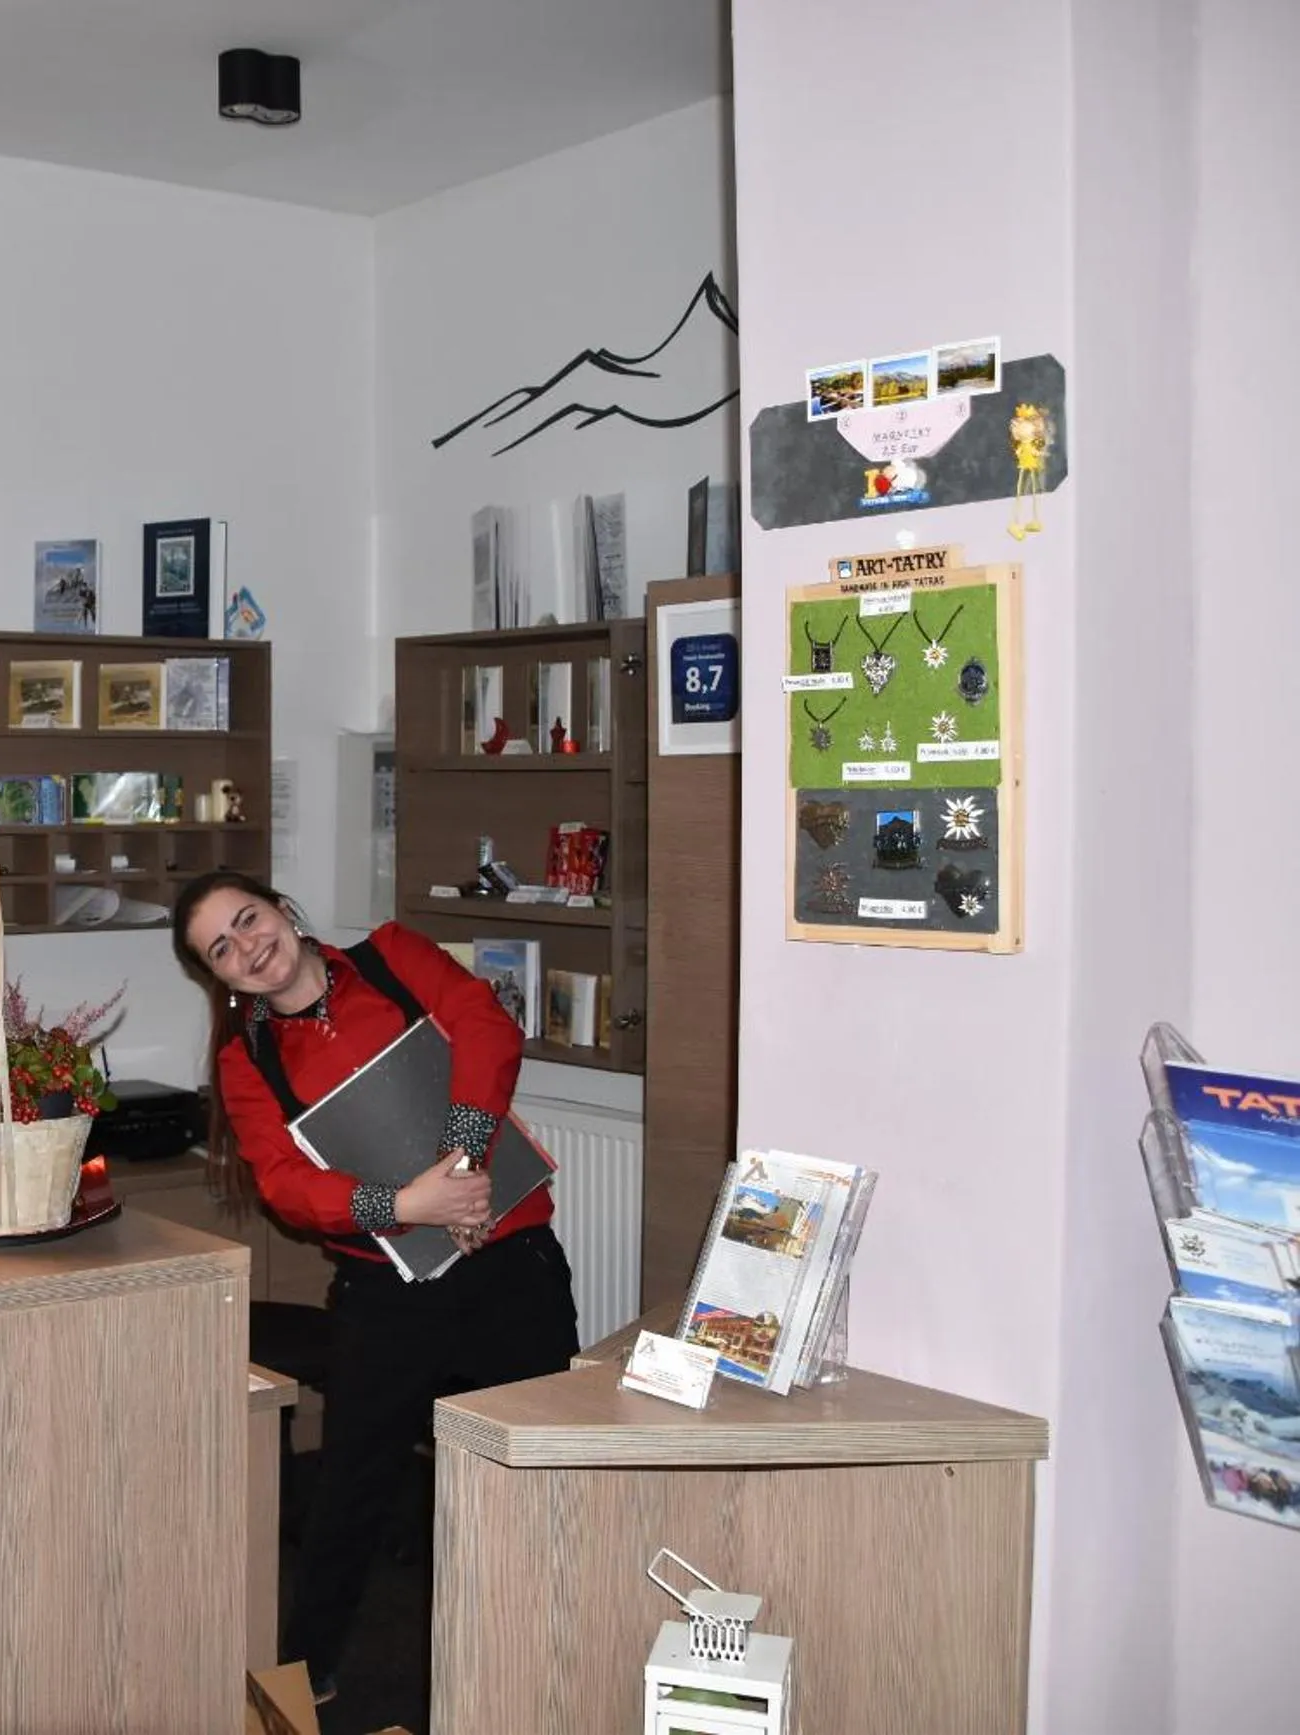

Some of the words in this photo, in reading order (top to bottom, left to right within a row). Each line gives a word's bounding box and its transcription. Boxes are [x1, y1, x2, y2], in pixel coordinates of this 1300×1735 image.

[855, 550, 948, 578] ART-TATRY
[914, 575, 946, 587] TATRAS
[685, 665, 724, 694] 8,7
[1202, 1086, 1300, 1117] TAT
